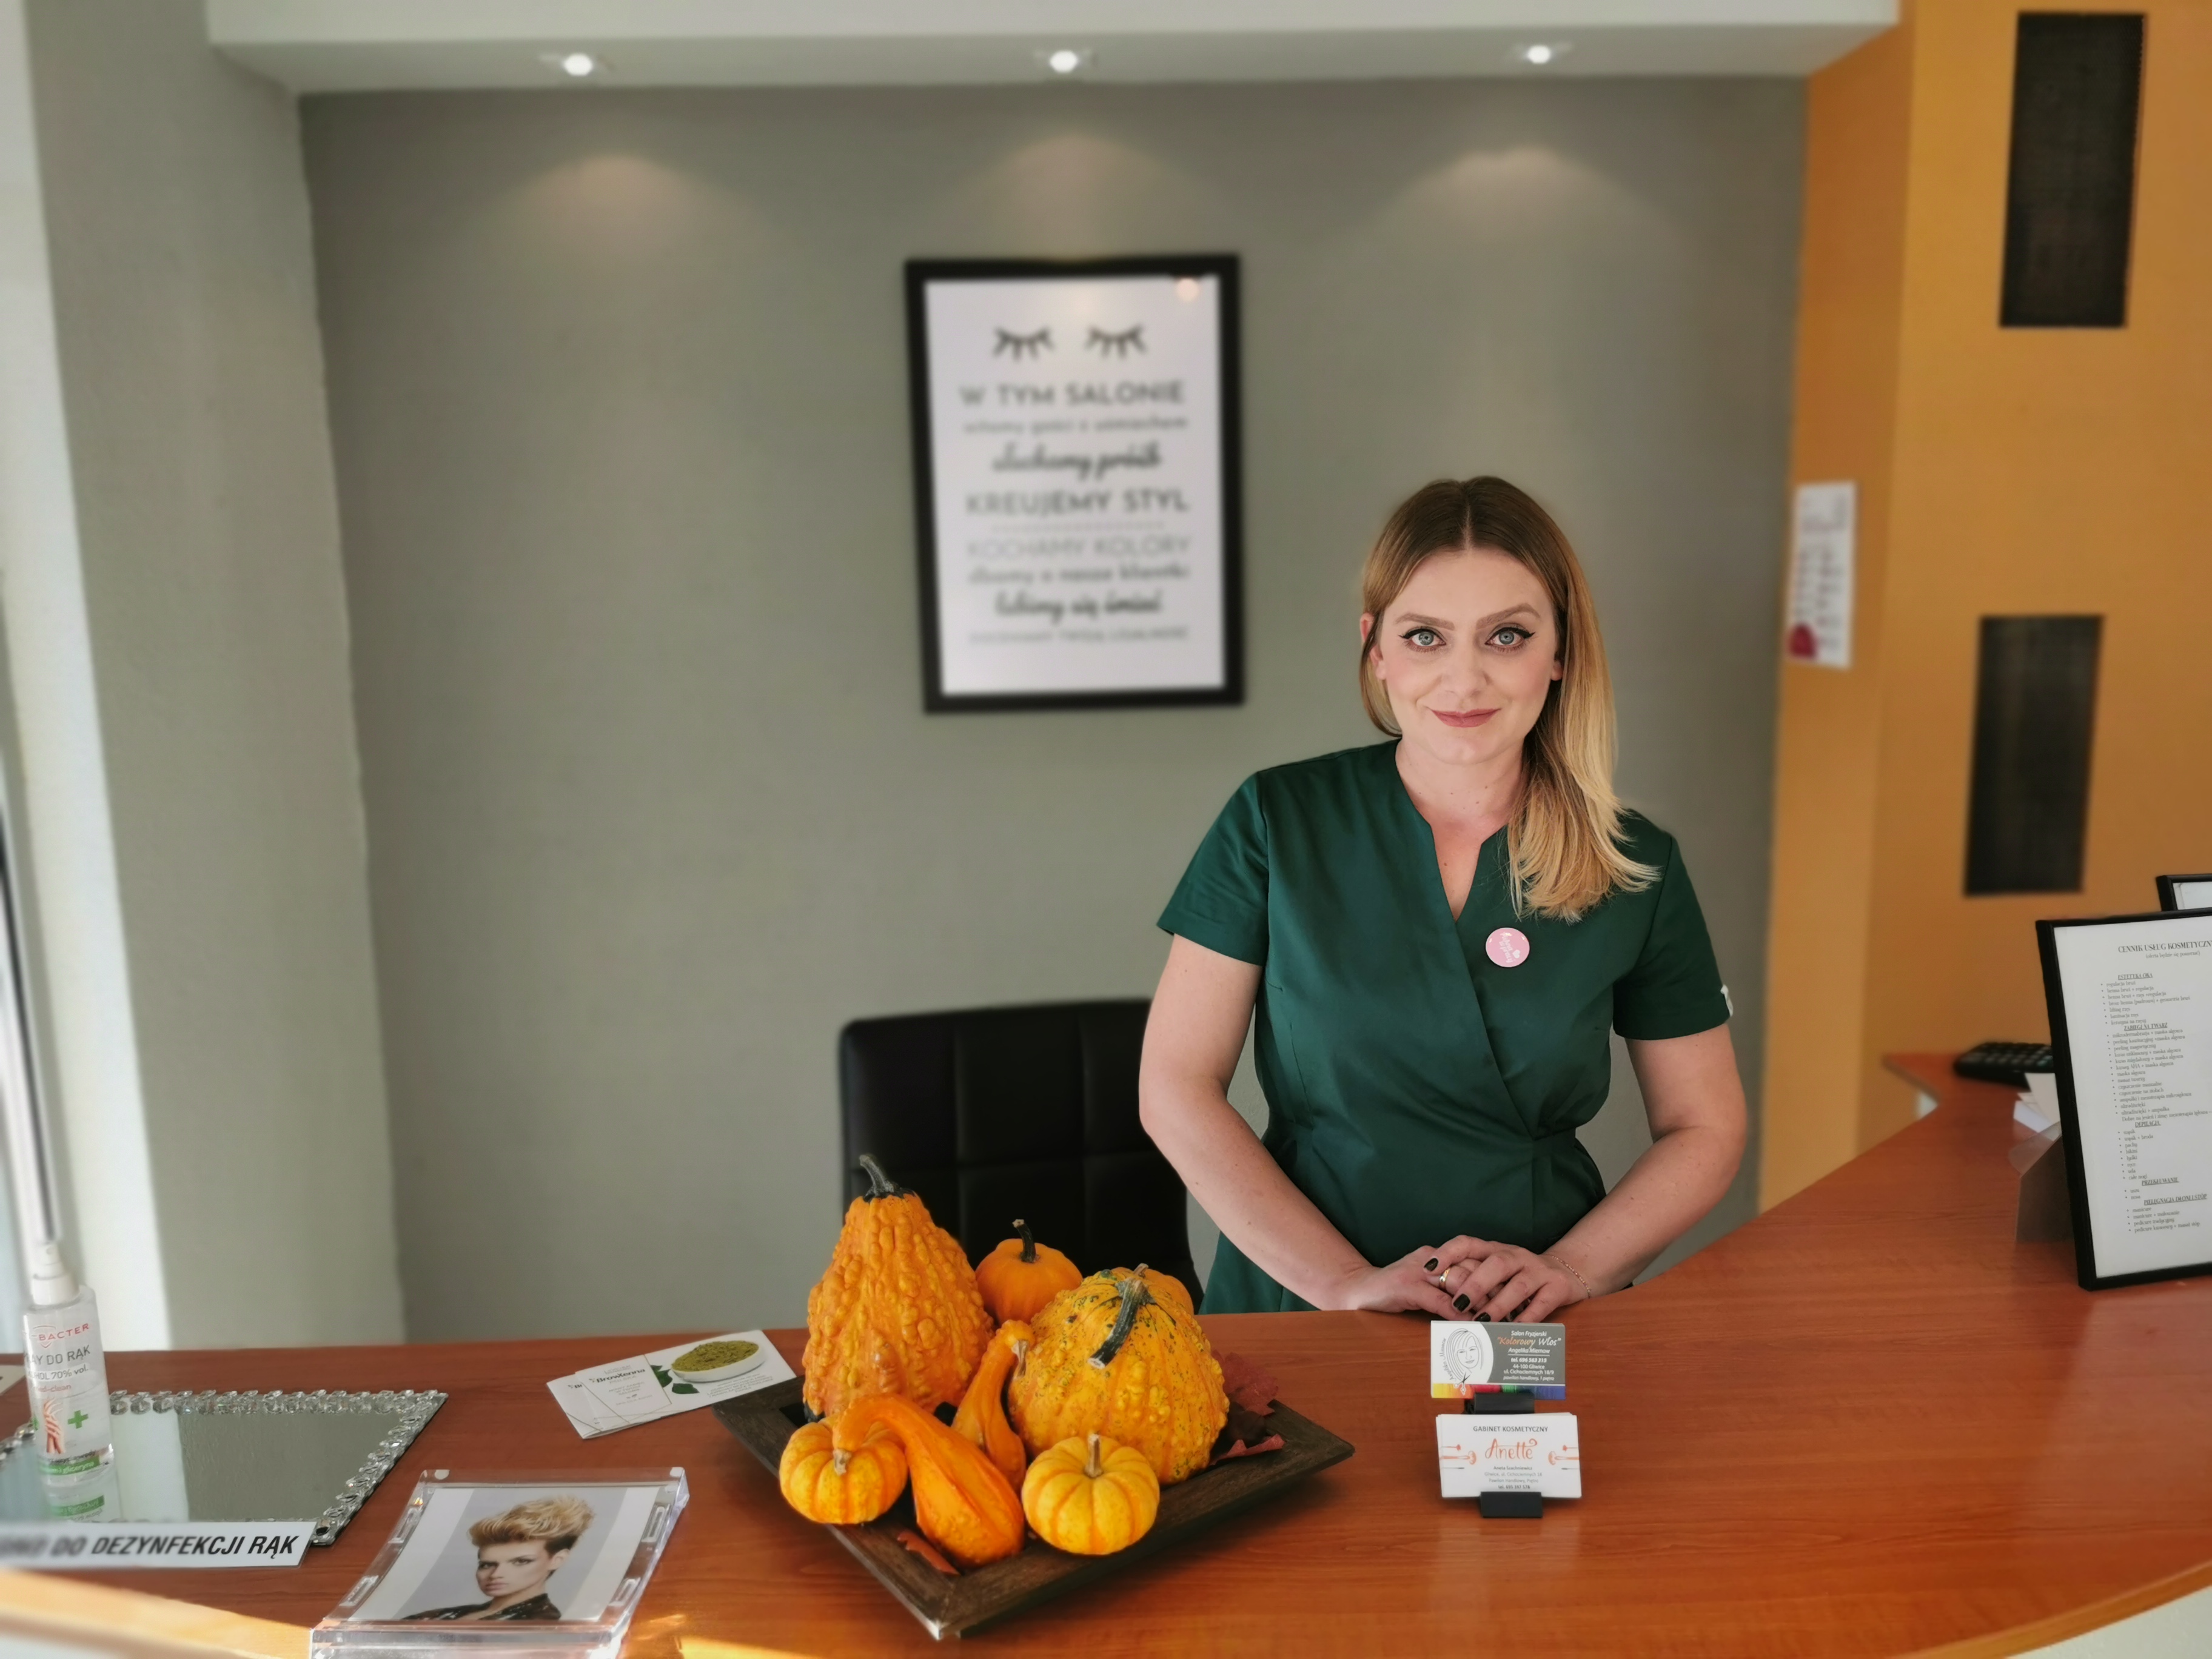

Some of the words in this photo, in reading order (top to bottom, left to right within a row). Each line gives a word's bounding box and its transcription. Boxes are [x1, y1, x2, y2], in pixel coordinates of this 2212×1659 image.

[997, 383, 1055, 406] TYM
[1065, 379, 1184, 406] SALONIE
[965, 489, 1111, 517] KREUJEMY
[1123, 487, 1189, 513] STYL
[967, 537, 1085, 559] KOCHAMY
[1094, 534, 1191, 556] KOLORY
[2168, 940, 2212, 950] KOSMETYCZN
[47, 1354, 63, 1365] DO
[67, 1345, 90, 1362] RĄK
[51, 1369, 72, 1379] 70%
[74, 1364, 89, 1375] vol.
[1485, 1438, 1538, 1460] Anette
[50, 1537, 88, 1558] DO
[91, 1535, 246, 1555] DEZYNFEKCJI
[247, 1535, 300, 1560] RĄK
